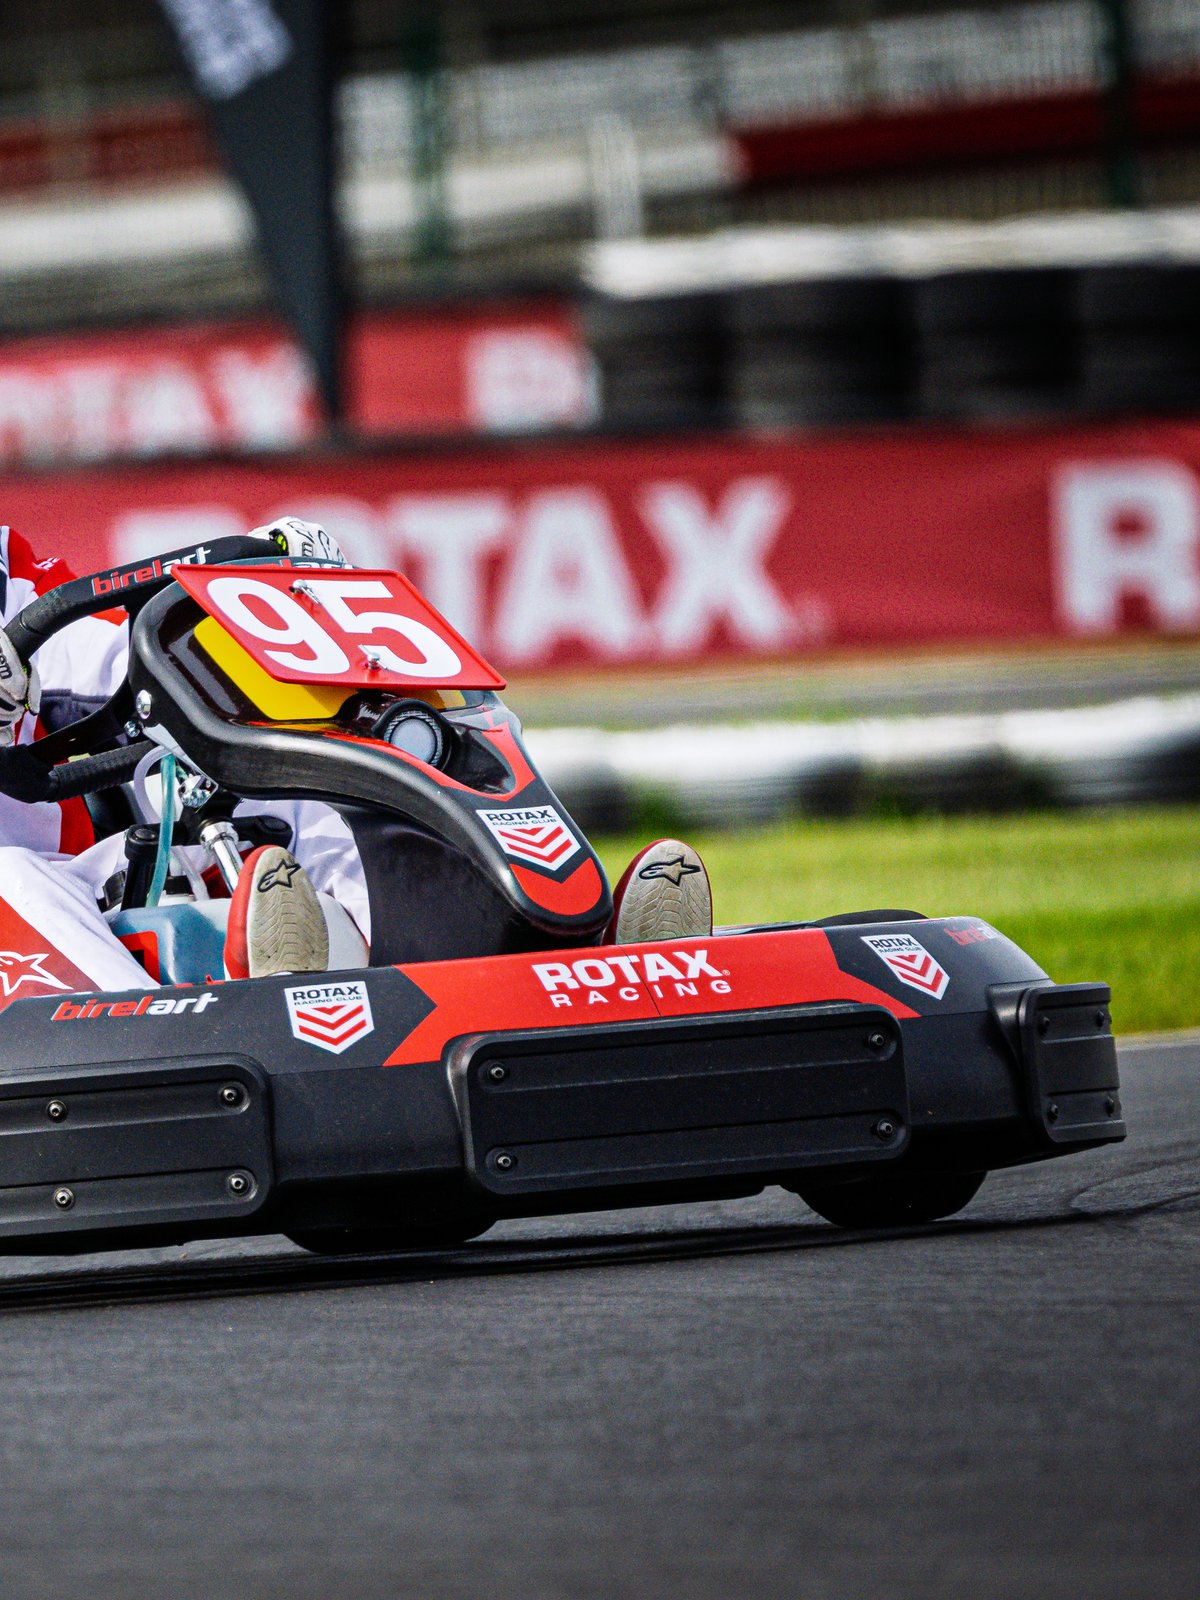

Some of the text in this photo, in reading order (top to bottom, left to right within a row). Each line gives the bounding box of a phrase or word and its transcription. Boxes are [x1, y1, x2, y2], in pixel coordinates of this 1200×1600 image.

[206, 577, 462, 678] 95
[485, 809, 553, 821] ROTAX
[870, 937, 917, 949] ROTAX
[532, 949, 726, 992] ROTAX
[292, 985, 360, 1001] ROTAX
[294, 998, 333, 1006] RACING
[550, 978, 732, 1009] RACING
[50, 992, 219, 1022] birelart
